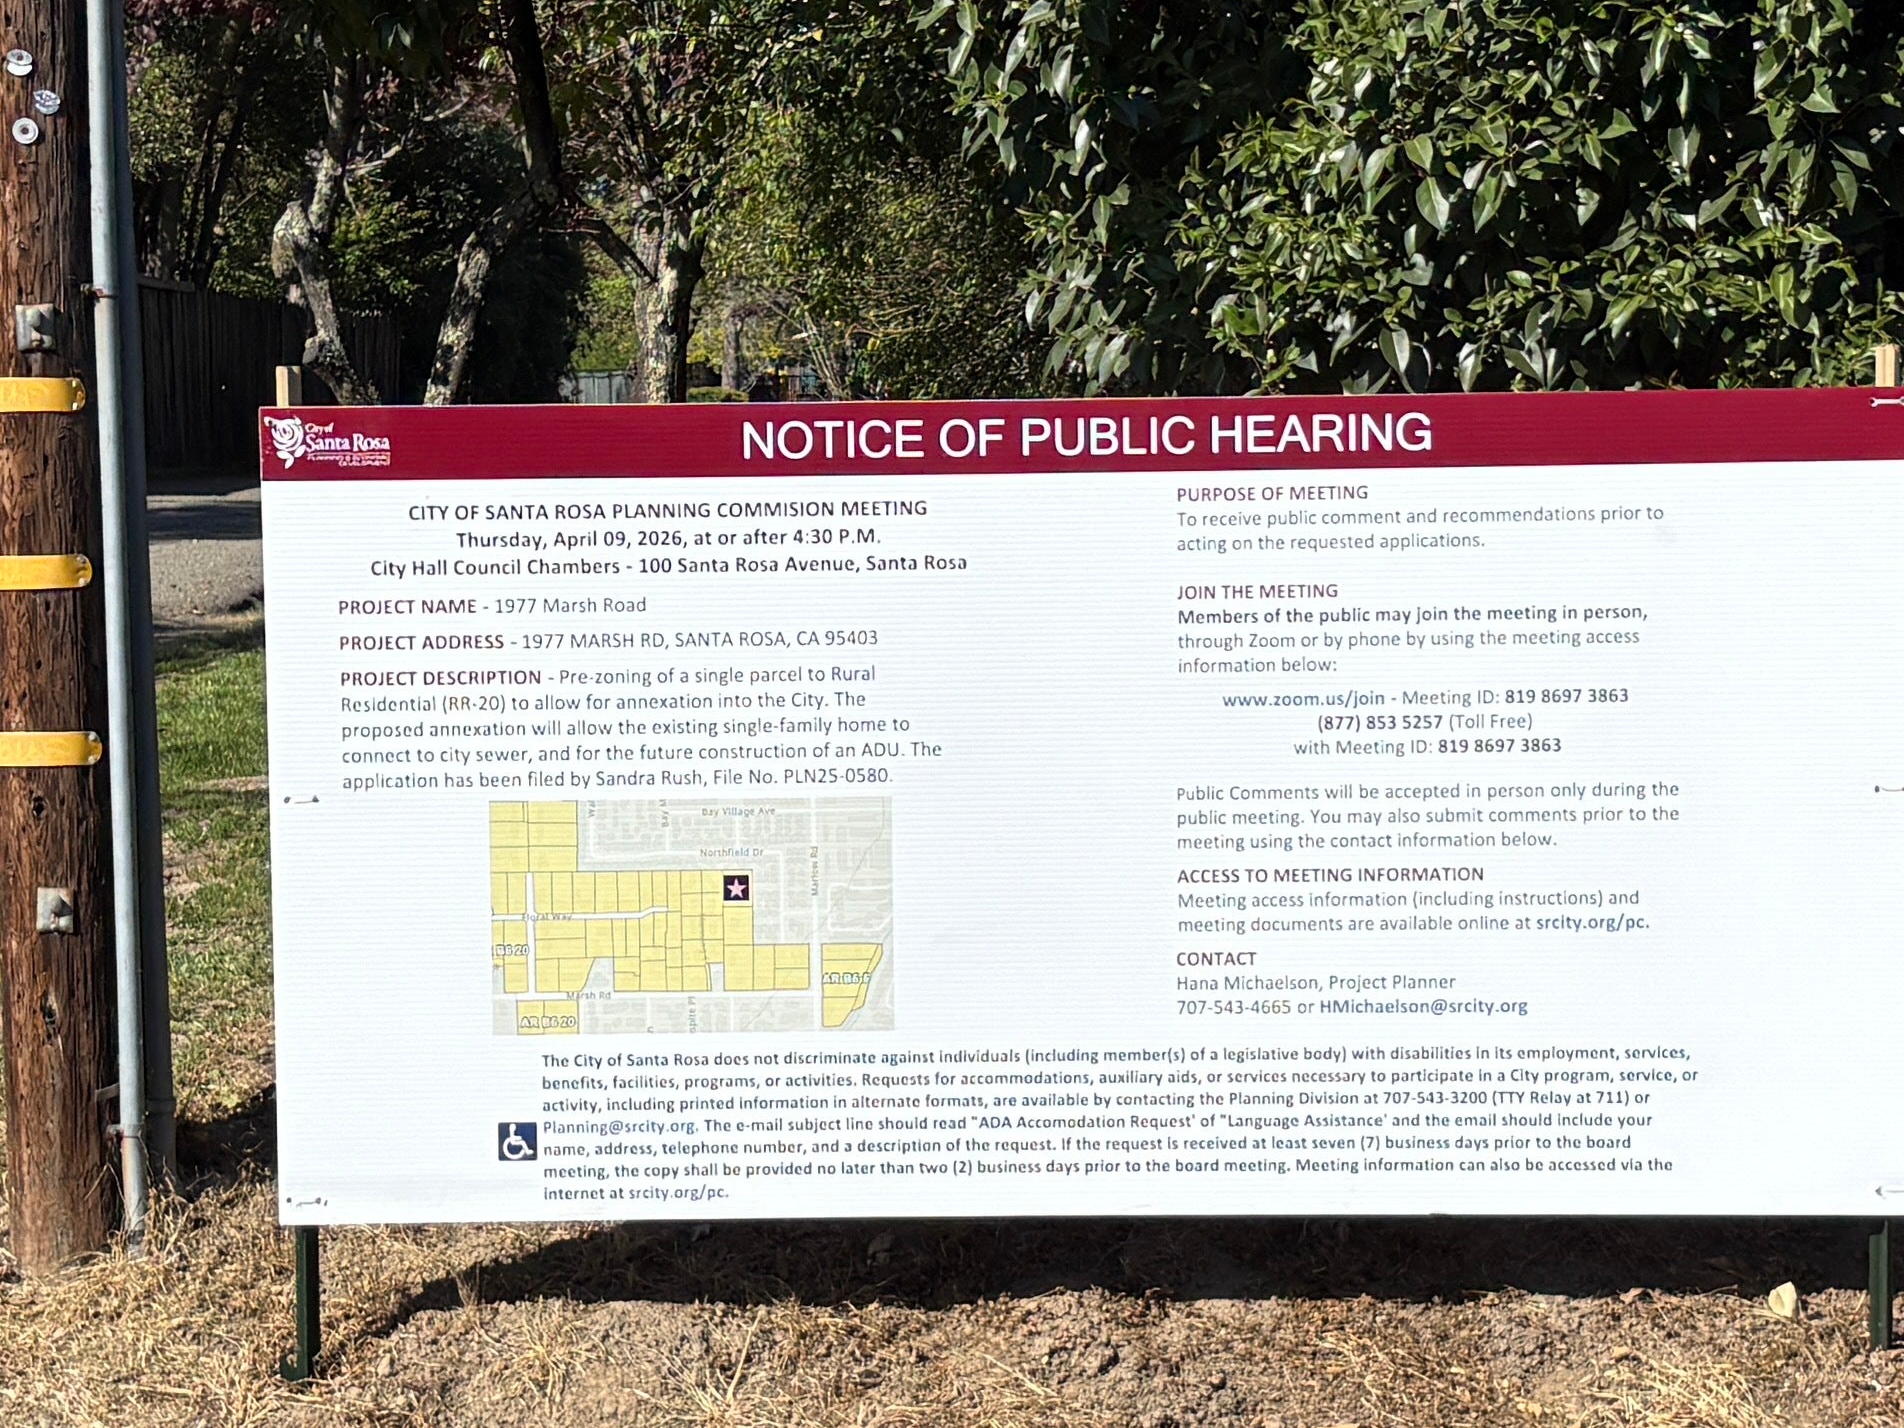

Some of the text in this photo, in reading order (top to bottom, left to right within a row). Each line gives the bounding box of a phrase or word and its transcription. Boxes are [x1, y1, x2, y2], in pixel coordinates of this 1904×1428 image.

[305, 433, 390, 452] Santa Rosa
[742, 412, 1433, 460] NOTICE OF PUBLIC HEARING
[1176, 484, 1369, 503] PURPOSE OF MEETING
[407, 499, 928, 521] CITY OF SANTA ROSA PLANNING COMMISION MEETING
[1175, 505, 1665, 530] To receive public comment and recommendations prior to
[454, 527, 881, 552] Thursday, April 09, 2026, at or after 4:30 P.M.
[1176, 532, 1486, 555] acting on the requested applications.
[369, 558, 407, 580] City
[411, 557, 448, 577] Hall
[452, 557, 522, 576] Council
[526, 557, 621, 576] Chambers
[638, 556, 673, 574] 100
[676, 556, 730, 574] Santa
[734, 556, 779, 573] Rosa
[783, 555, 861, 574] Avenue,
[865, 554, 918, 572] Santa
[923, 553, 968, 571] Rosa
[1176, 582, 1339, 601] JOIN THE MEETING
[337, 598, 416, 616] PROJECT
[420, 598, 478, 615] NAME
[494, 597, 537, 615] 1977
[542, 596, 598, 614] Marsh
[602, 595, 647, 613] Road
[1177, 603, 1648, 627] Members of the public may join the meeting in person,
[338, 634, 418, 651] PROJECT
[420, 633, 505, 651] ADDRESS
[521, 632, 565, 650] 1977
[569, 631, 634, 650] MARSH
[640, 631, 670, 651] RD,
[674, 630, 734, 648] SANTA
[738, 630, 791, 649] ROSA,
[795, 629, 821, 647] CA
[823, 628, 879, 647] 95403
[340, 670, 419, 687] PROJECT
[422, 669, 542, 687] DESCRIPTION
[558, 667, 652, 688] Pre-zoning
[656, 666, 675, 685] of
[678, 670, 689, 684] a
[694, 665, 745, 687] single
[749, 664, 803, 687] parcel
[807, 667, 826, 682] to
[830, 663, 876, 682] Rural
[1221, 688, 1386, 710] www.zoom.us/join
[1401, 688, 1472, 709] Meeting
[1476, 688, 1500, 705] ID:
[1503, 688, 1536, 705] 819
[1540, 687, 1583, 704] 8697
[1587, 687, 1629, 704] 3863
[1317, 711, 1533, 735] (877) 853 5257 (Toll Free)
[1292, 736, 1562, 758] with Meeting ID: 819 8697 3863
[342, 766, 894, 793] application has been filed by Sandra Rush, File No. PLN25-0580.
[722, 807, 756, 818] Village
[757, 806, 776, 816] Ave
[700, 847, 764, 858] Northfield Dr
[1176, 865, 1484, 884] ACCESS TO MEETING INFORMATION
[1177, 911, 1650, 936] meeting documents are available online at srcity.org/pc.
[1175, 950, 1258, 967] CONTACT
[1176, 973, 1457, 994] Hana Michaelson, Project Planner
[598, 990, 612, 1001] Rd
[1175, 997, 1529, 1017] 707-543-4665 or HMichaelson@srcity.org
[543, 1182, 730, 1203] internet at srcity.org/pc.
